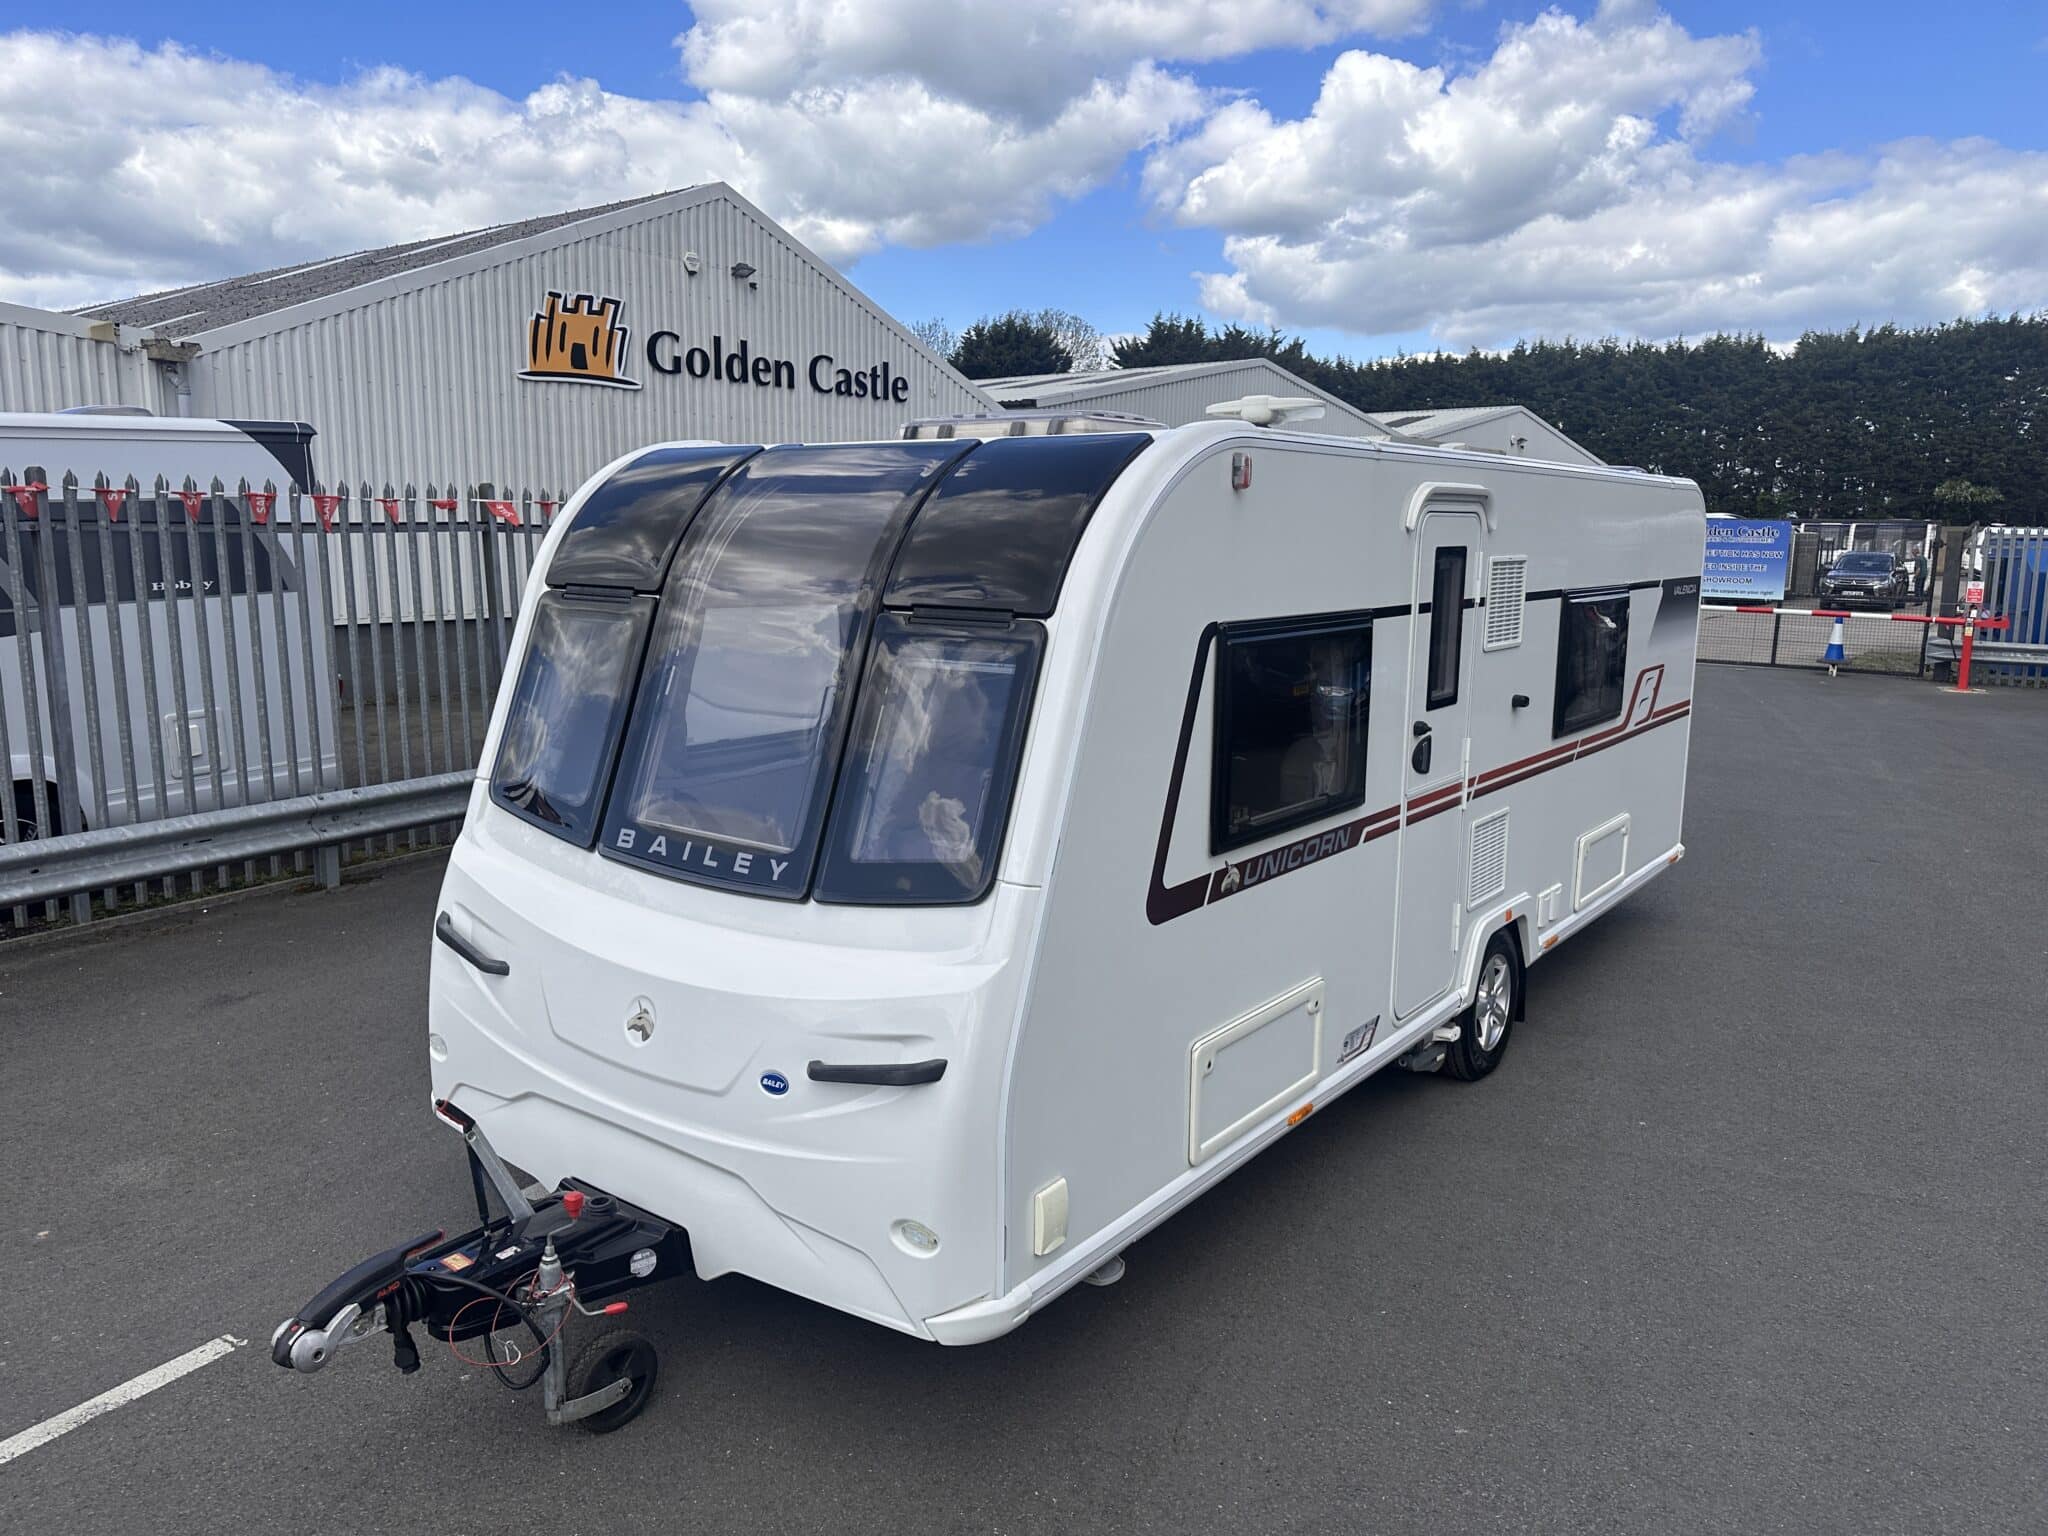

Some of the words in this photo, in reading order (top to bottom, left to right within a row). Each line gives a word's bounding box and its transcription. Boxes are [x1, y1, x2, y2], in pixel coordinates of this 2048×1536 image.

[646, 330, 795, 390] Golden
[809, 354, 909, 403] Castle
[1707, 524, 1733, 537] den
[1737, 525, 1780, 538] Castle
[1740, 549, 1760, 558] HAS
[1761, 550, 1784, 560] NOW
[1719, 563, 1747, 571] INSIDE
[1749, 563, 1767, 572] THE
[616, 828, 789, 881] BAILEY
[1243, 826, 1351, 886] UNICORN
[762, 1077, 785, 1089] BAILEY
